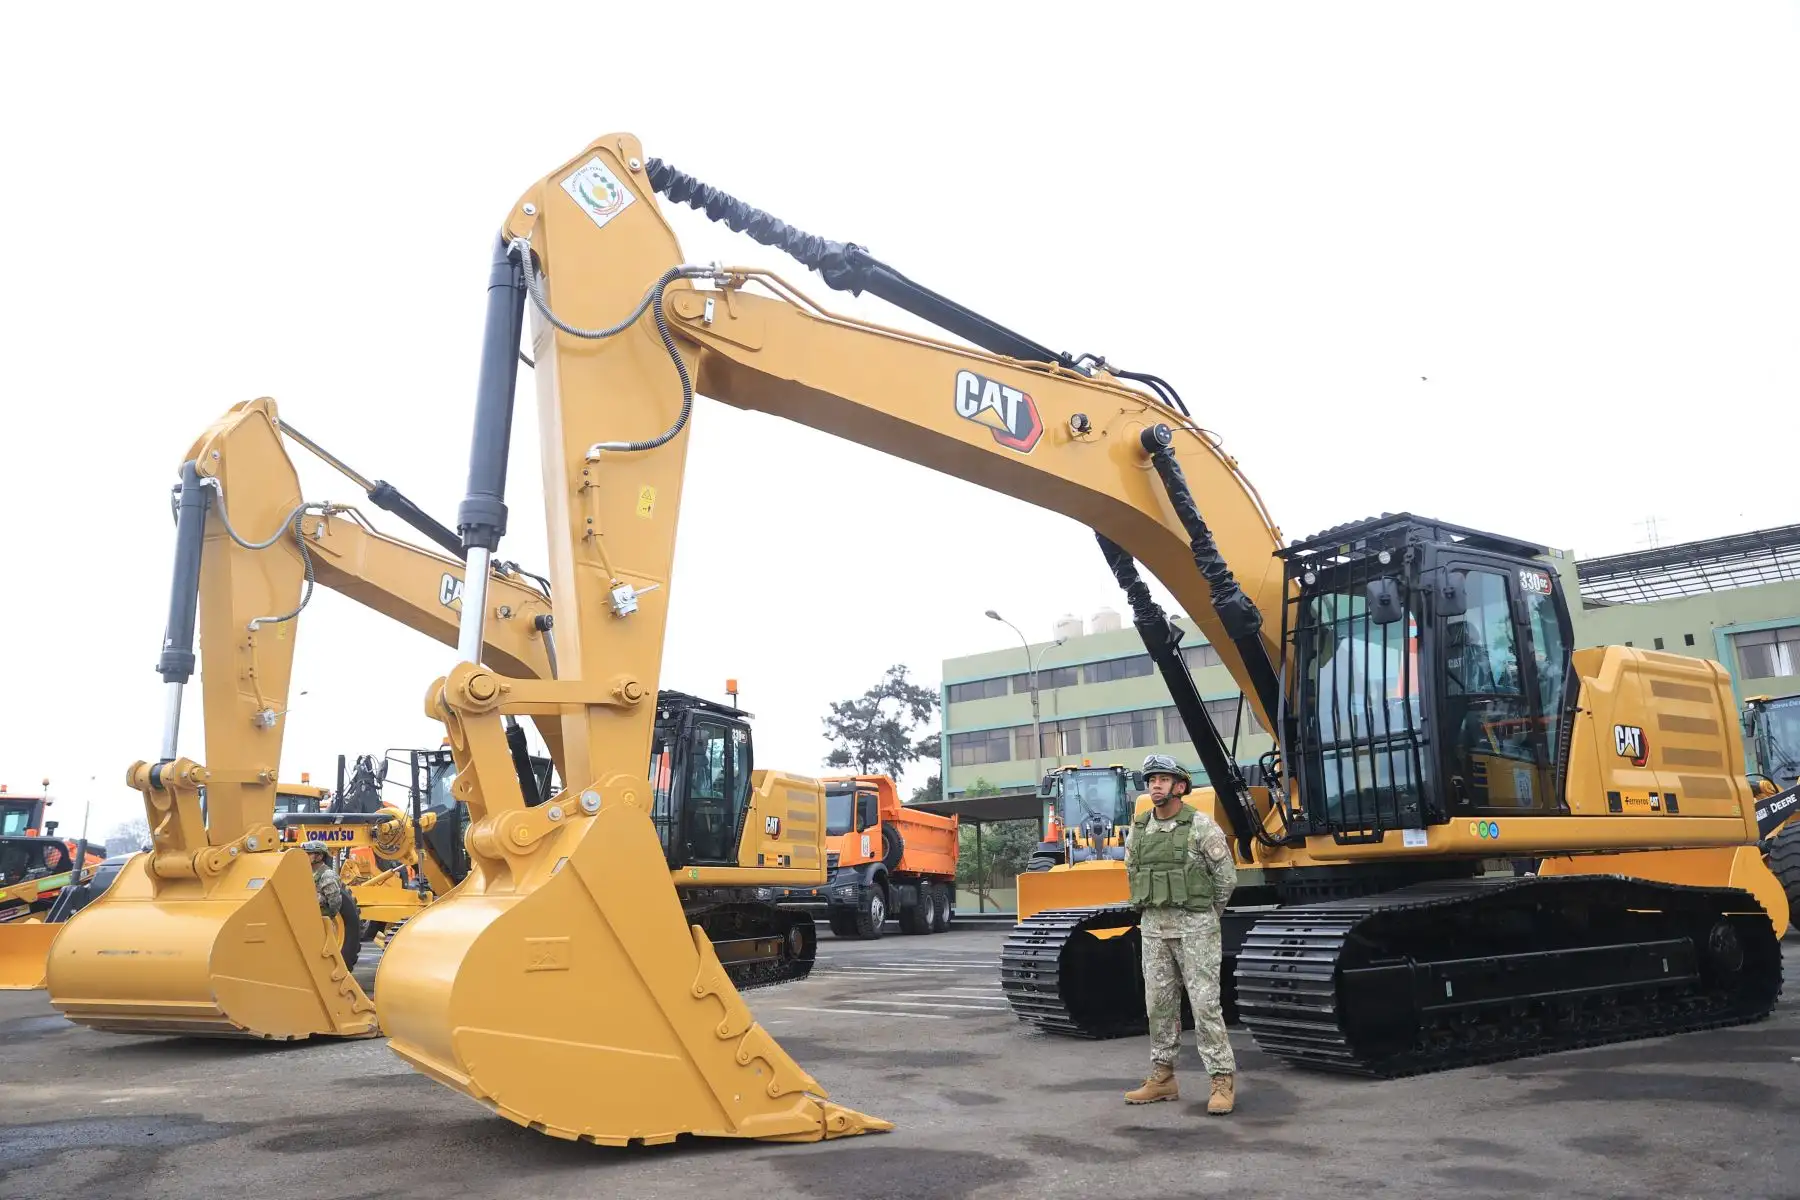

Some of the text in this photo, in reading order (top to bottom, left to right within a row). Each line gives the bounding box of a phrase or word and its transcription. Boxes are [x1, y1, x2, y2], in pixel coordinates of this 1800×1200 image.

[956, 371, 1023, 435] CAT
[440, 573, 465, 605] CA
[1519, 571, 1540, 591] 330
[1614, 725, 1640, 757] CAT
[1769, 793, 1798, 814] DEERE
[765, 816, 779, 835] CAT
